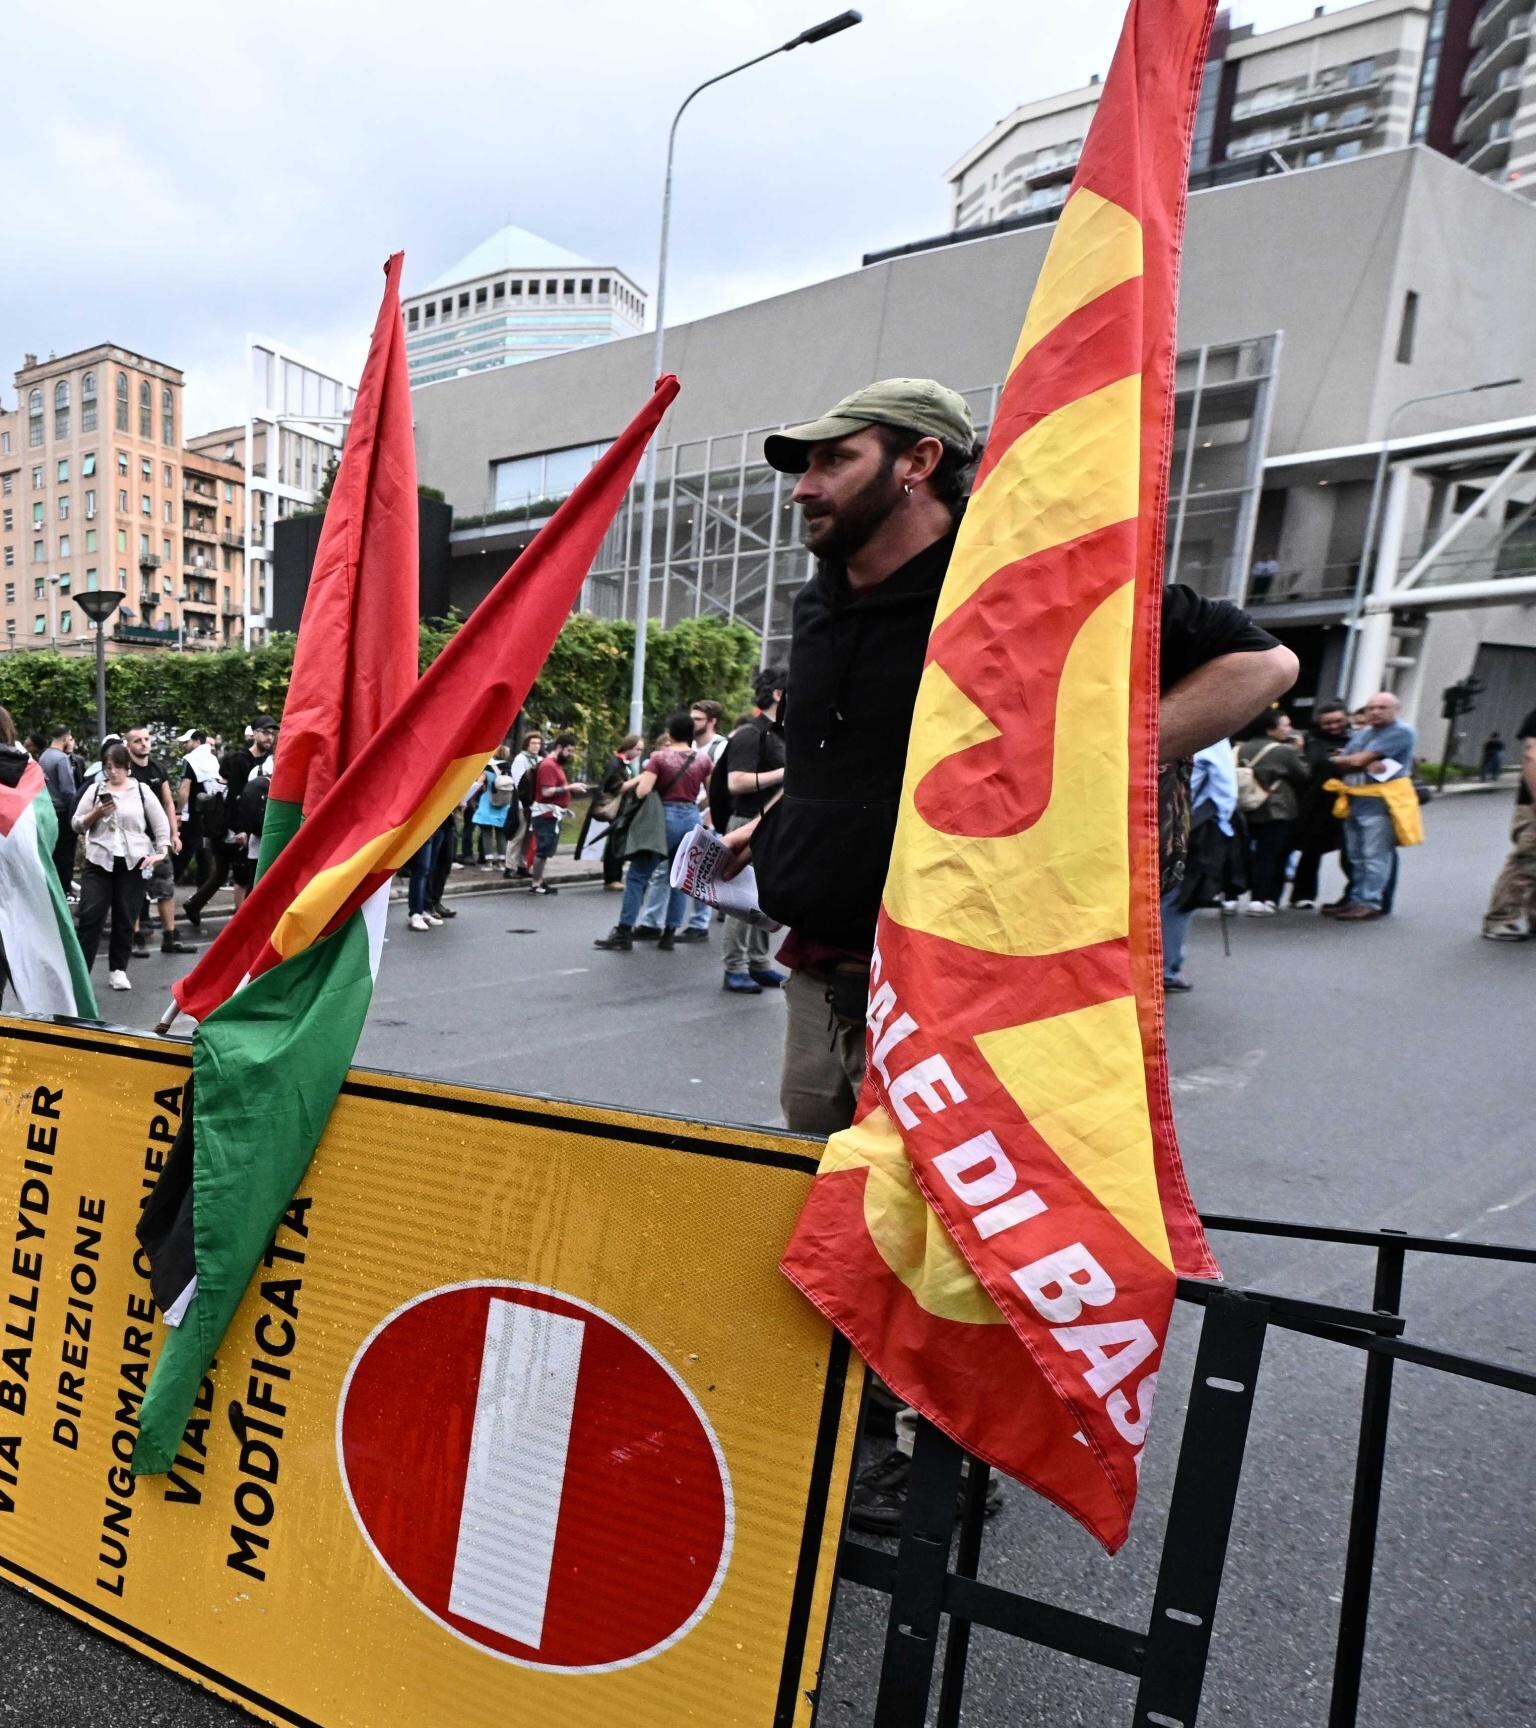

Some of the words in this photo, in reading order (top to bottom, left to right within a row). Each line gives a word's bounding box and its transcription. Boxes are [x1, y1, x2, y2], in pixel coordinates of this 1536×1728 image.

[53, 1195, 106, 1451] DIREZIONE
[96, 1293, 156, 1597] LUNGOMARE
[227, 1197, 313, 1582] MODIFICATA
[932, 1131, 1048, 1240] DI
[1010, 1241, 1159, 1482] BAS
